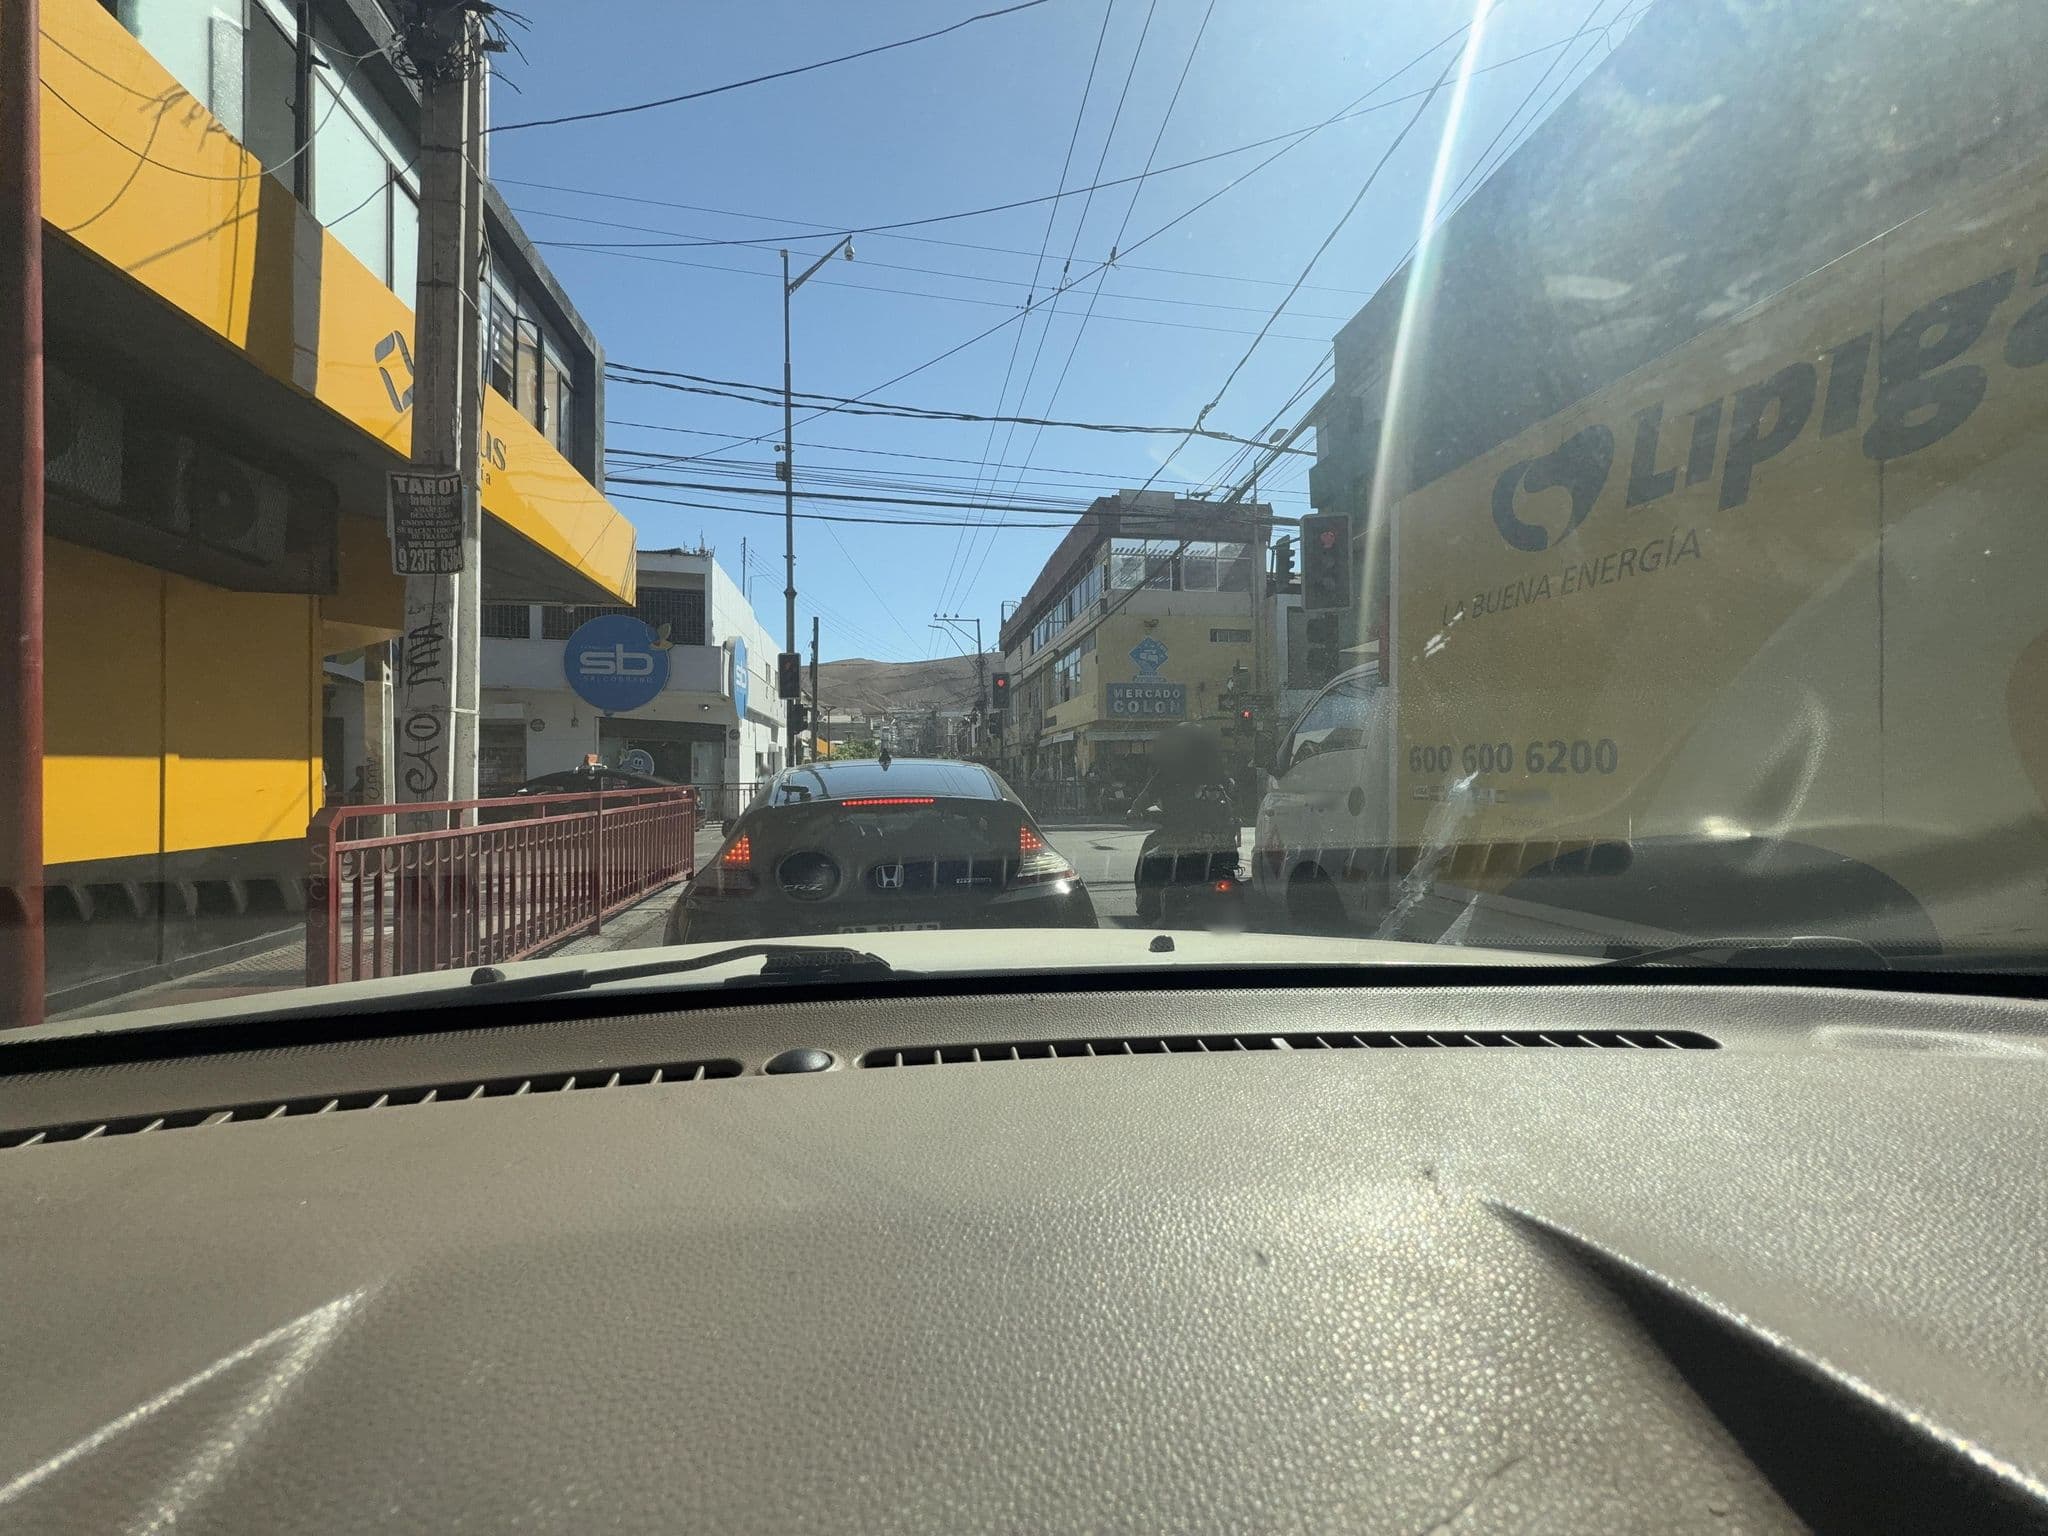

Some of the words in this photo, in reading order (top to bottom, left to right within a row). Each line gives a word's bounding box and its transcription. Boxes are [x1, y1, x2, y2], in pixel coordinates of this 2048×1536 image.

[392, 476, 460, 495] TAROT
[398, 548, 408, 571] 9
[1442, 601, 1465, 626] LA
[1471, 574, 1551, 619] BUENA
[1560, 525, 1701, 595] ENERGÍA
[579, 643, 655, 676] sb
[1113, 687, 1181, 699] MERCADO
[1408, 743, 1453, 774] 600
[1461, 742, 1514, 774] 600
[1525, 737, 1619, 775] 6200
